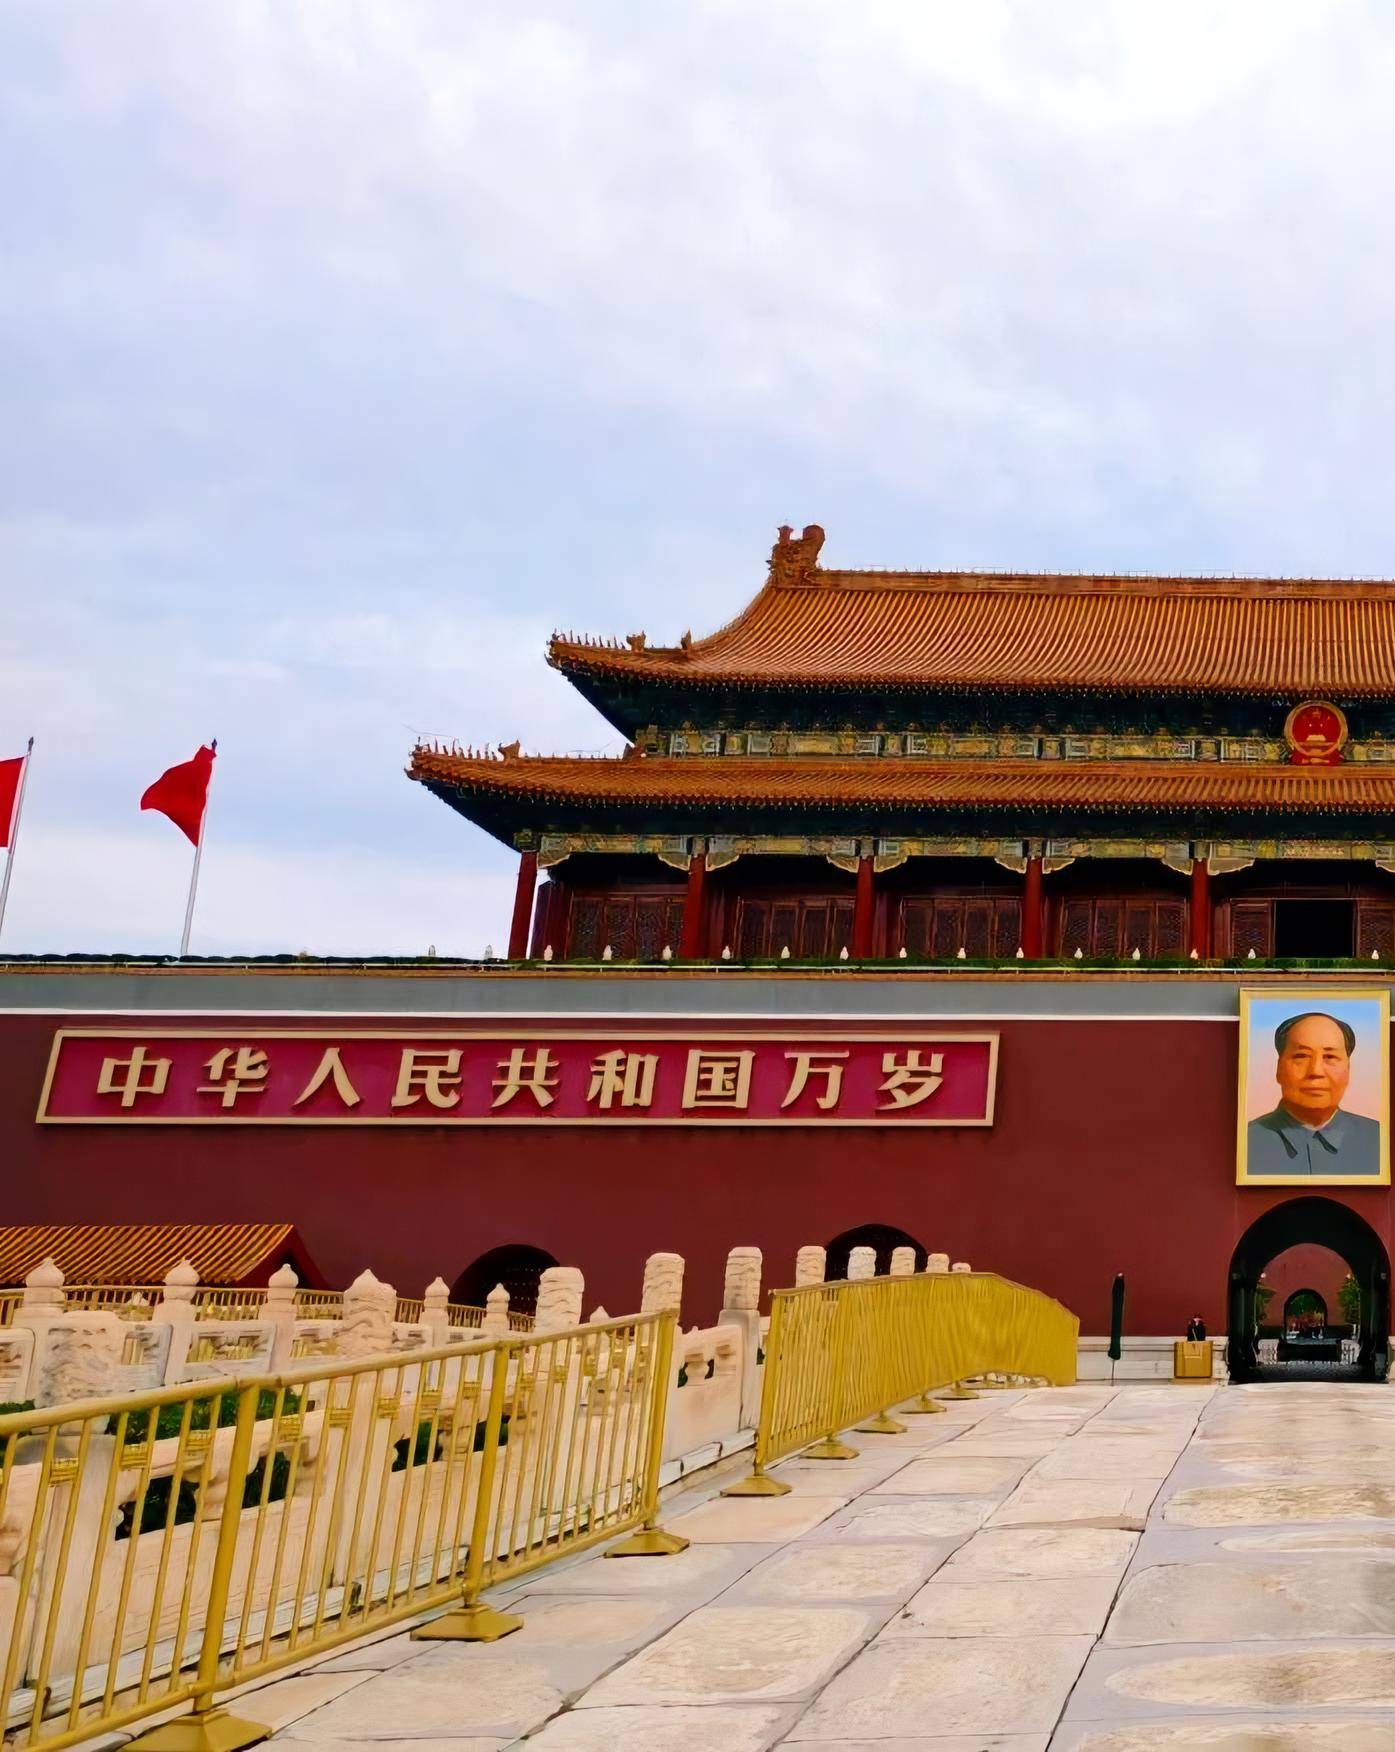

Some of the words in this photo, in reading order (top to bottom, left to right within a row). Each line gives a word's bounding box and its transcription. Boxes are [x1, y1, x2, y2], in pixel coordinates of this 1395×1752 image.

[95, 1046, 947, 1111] 中华人民共和国万岁
